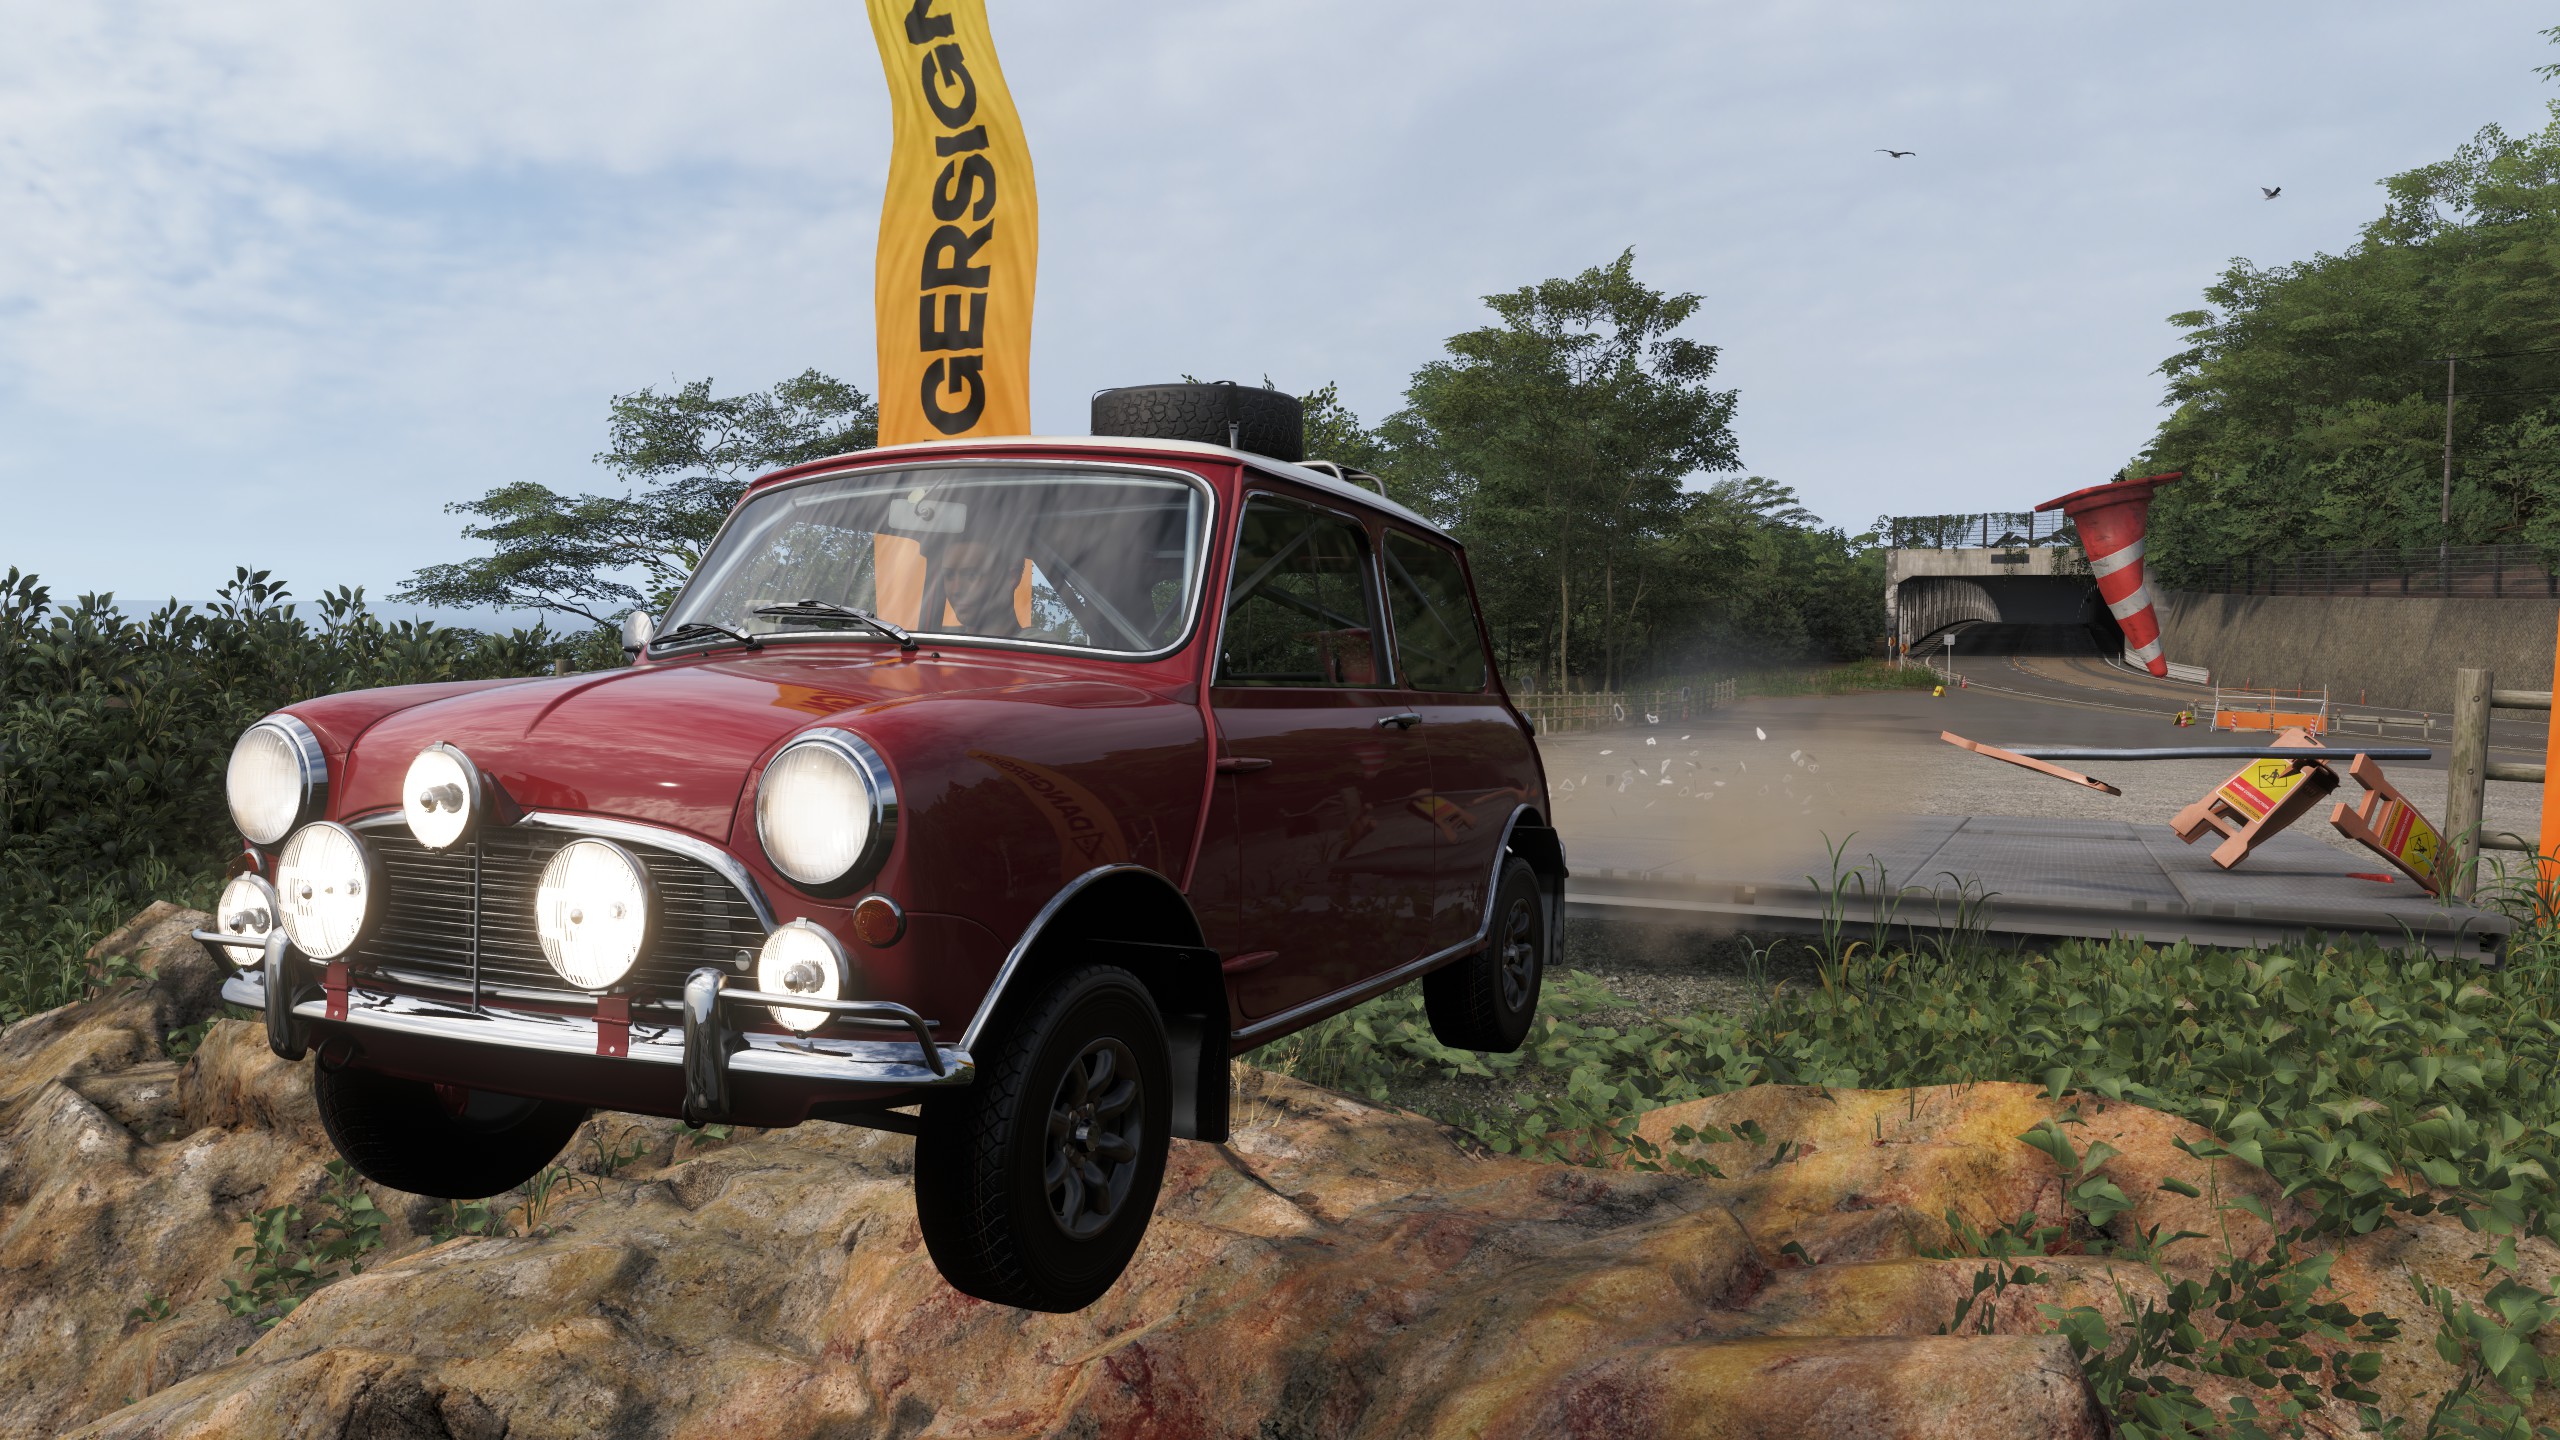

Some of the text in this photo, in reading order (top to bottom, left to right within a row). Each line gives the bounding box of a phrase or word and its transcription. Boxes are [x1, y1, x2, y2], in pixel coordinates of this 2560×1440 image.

[904, 0, 997, 442] GERSIGN
[2221, 790, 2260, 819] UNDER CONSTRUCTION
[2232, 781, 2270, 810] UNDER CONSTRUCTION
